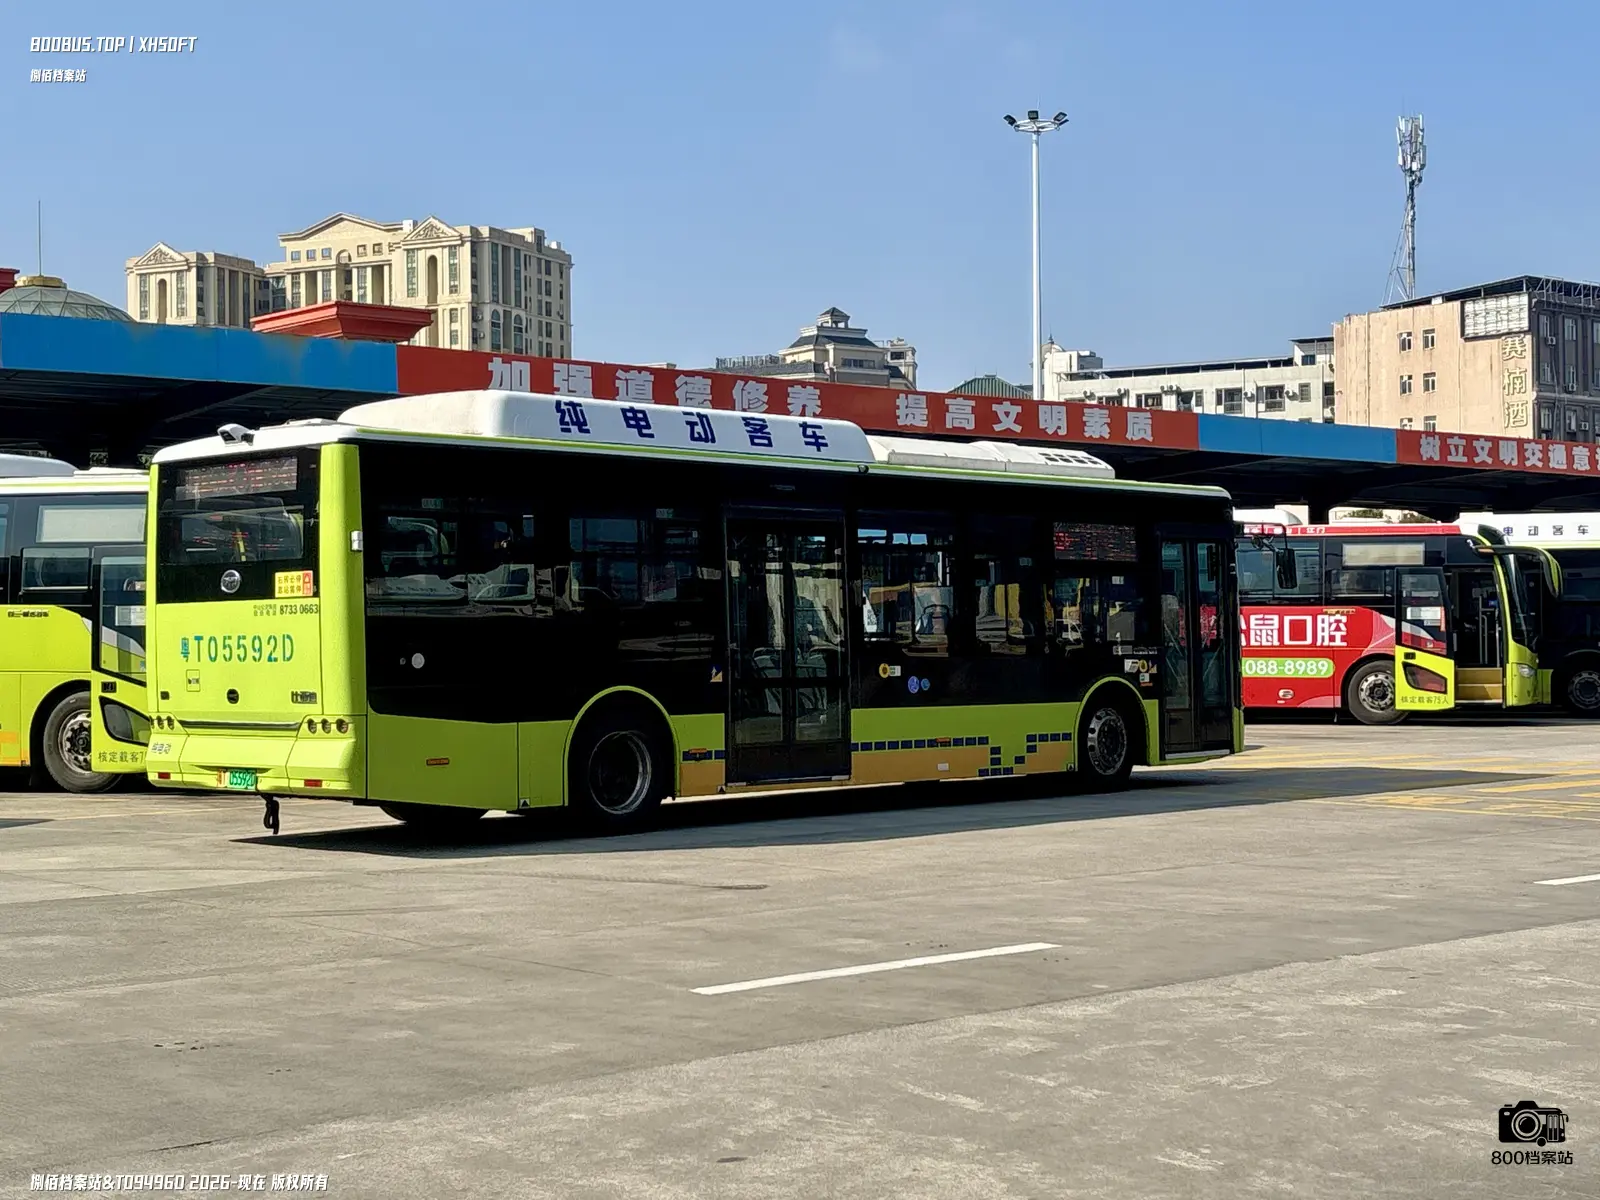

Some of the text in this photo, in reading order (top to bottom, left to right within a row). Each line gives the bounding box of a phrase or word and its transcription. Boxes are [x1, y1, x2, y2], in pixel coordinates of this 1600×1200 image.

[487, 357, 1154, 443] 加强道德修养 提高文明素质
[555, 400, 829, 453] 纯电动客车
[1419, 433, 1600, 472] 树立文明交通意
[1503, 525, 1589, 536] 电动客车
[279, 604, 319, 615] 8733 0663
[180, 633, 294, 663] 粤T05592D
